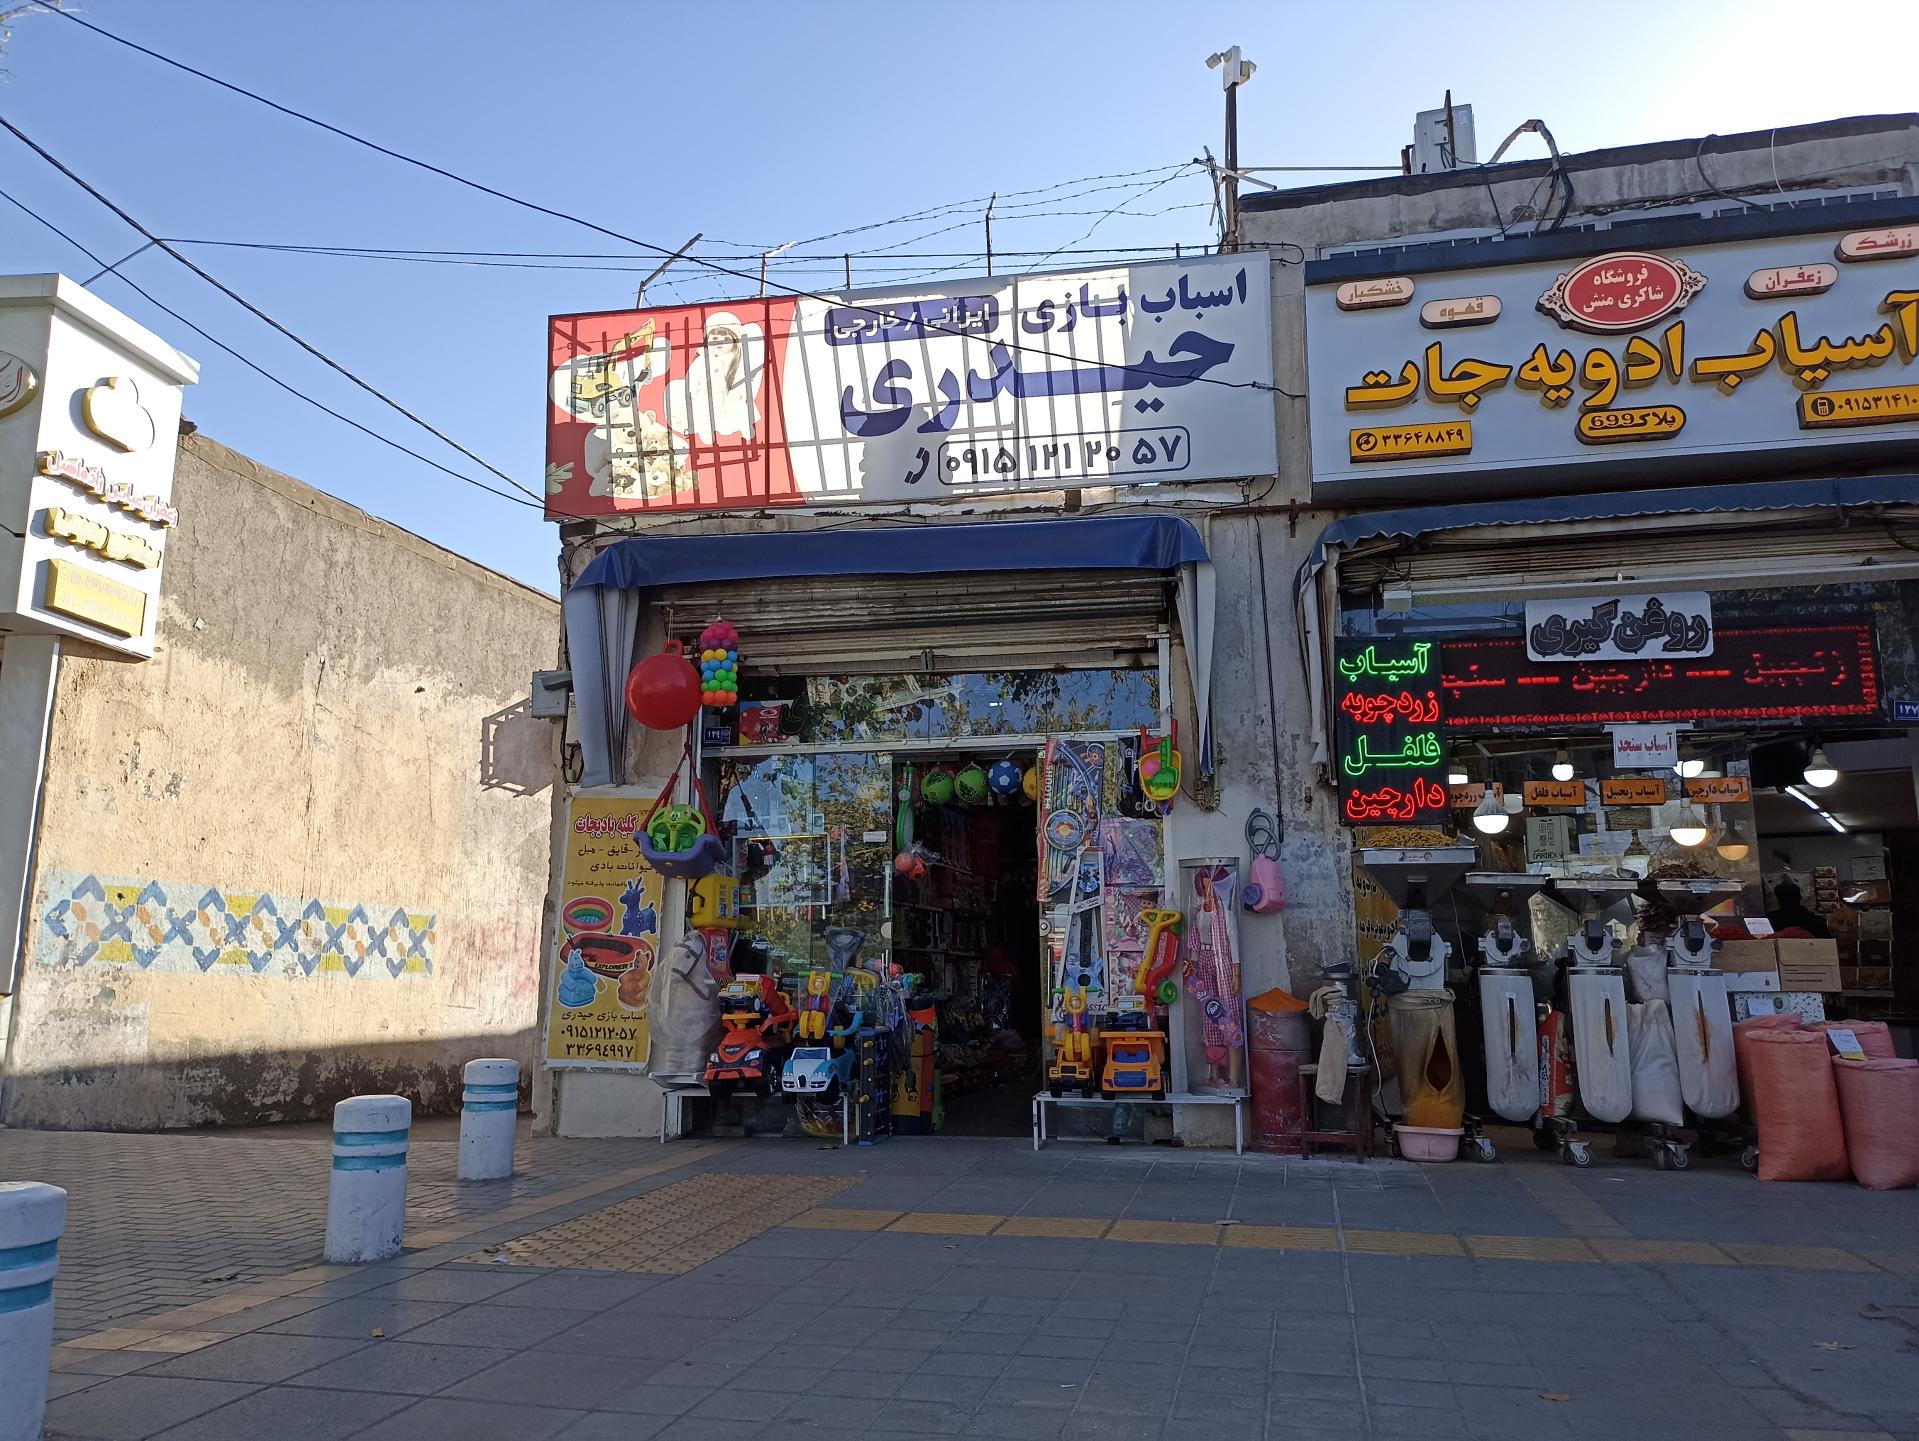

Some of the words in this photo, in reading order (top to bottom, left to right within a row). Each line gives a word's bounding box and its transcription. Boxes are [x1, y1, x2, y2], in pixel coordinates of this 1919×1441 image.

[1855, 232, 1912, 251] زرشک
[1593, 263, 1649, 286] فروشگاه
[1765, 267, 1822, 292] زعفران
[1140, 268, 1247, 323] اسباب
[1348, 280, 1403, 302] خشکبار
[1583, 293, 1614, 314] منش
[1618, 286, 1664, 309] شاکری
[922, 302, 990, 330] ایرانی
[1021, 283, 1128, 333] بازی
[1440, 296, 1484, 321] قهوه
[833, 313, 899, 340] خارجی
[1692, 290, 1919, 384] آسیاب
[1345, 340, 1514, 409] جات
[1517, 319, 1685, 408] ادویه
[840, 331, 1236, 438] حیدری
[1132, 434, 1182, 466] ۵۷
[1382, 428, 1465, 448] ۳۳۶۴۸۸۴۹
[1529, 598, 1621, 658] گیری
[1612, 597, 1712, 654] روغن
[1339, 642, 1432, 682] آسیاب
[1341, 690, 1440, 724] زردچوبه
[1344, 731, 1441, 776] فلفل
[1644, 731, 1673, 756] آسیاب
[1346, 776, 1446, 818] دارچین
[1530, 787, 1549, 801] فلفل
[1551, 787, 1577, 799] آسیاب
[1635, 784, 1660, 799] آسیاب
[1719, 781, 1744, 797] آسیاب
[616, 813, 639, 839] کلیه
[561, 1011, 594, 1021] حیدری
[597, 1011, 618, 1022] بازی
[621, 1011, 647, 1023] اسباب
